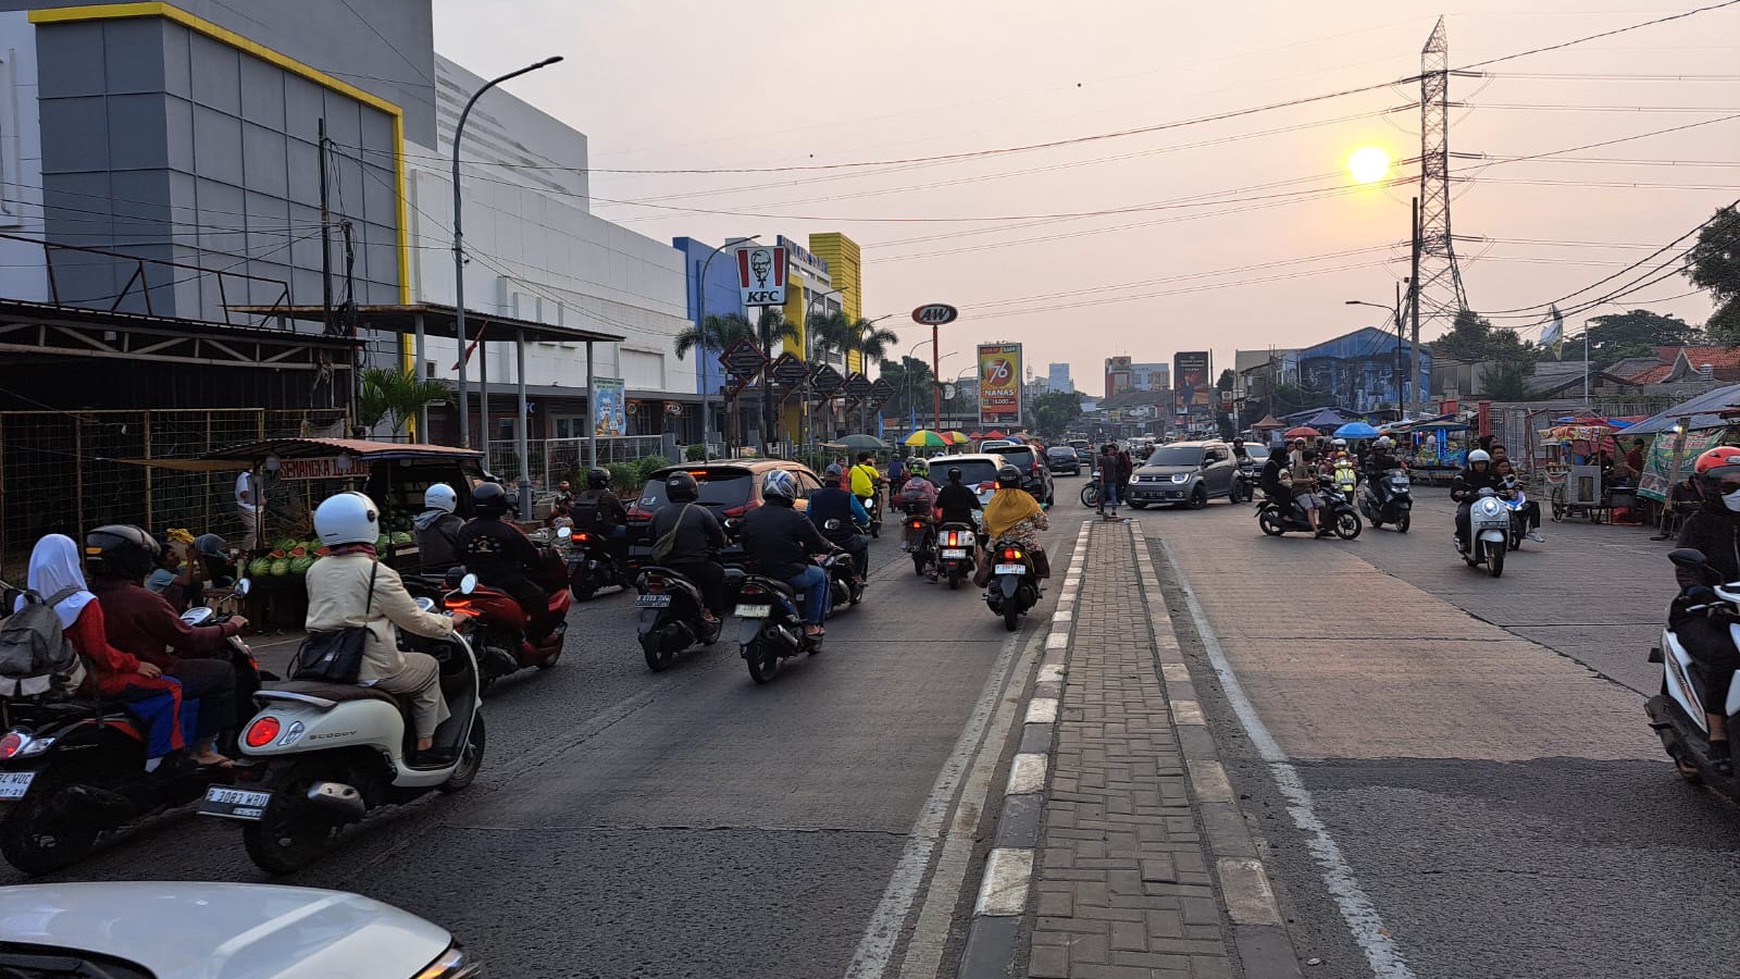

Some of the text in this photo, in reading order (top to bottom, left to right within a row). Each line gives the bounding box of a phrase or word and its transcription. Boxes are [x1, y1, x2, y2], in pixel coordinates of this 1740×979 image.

[746, 290, 779, 303] KFC
[989, 360, 1008, 383] 76
[985, 389, 1014, 397] NANAS
[281, 459, 331, 479] SEMANGKA
